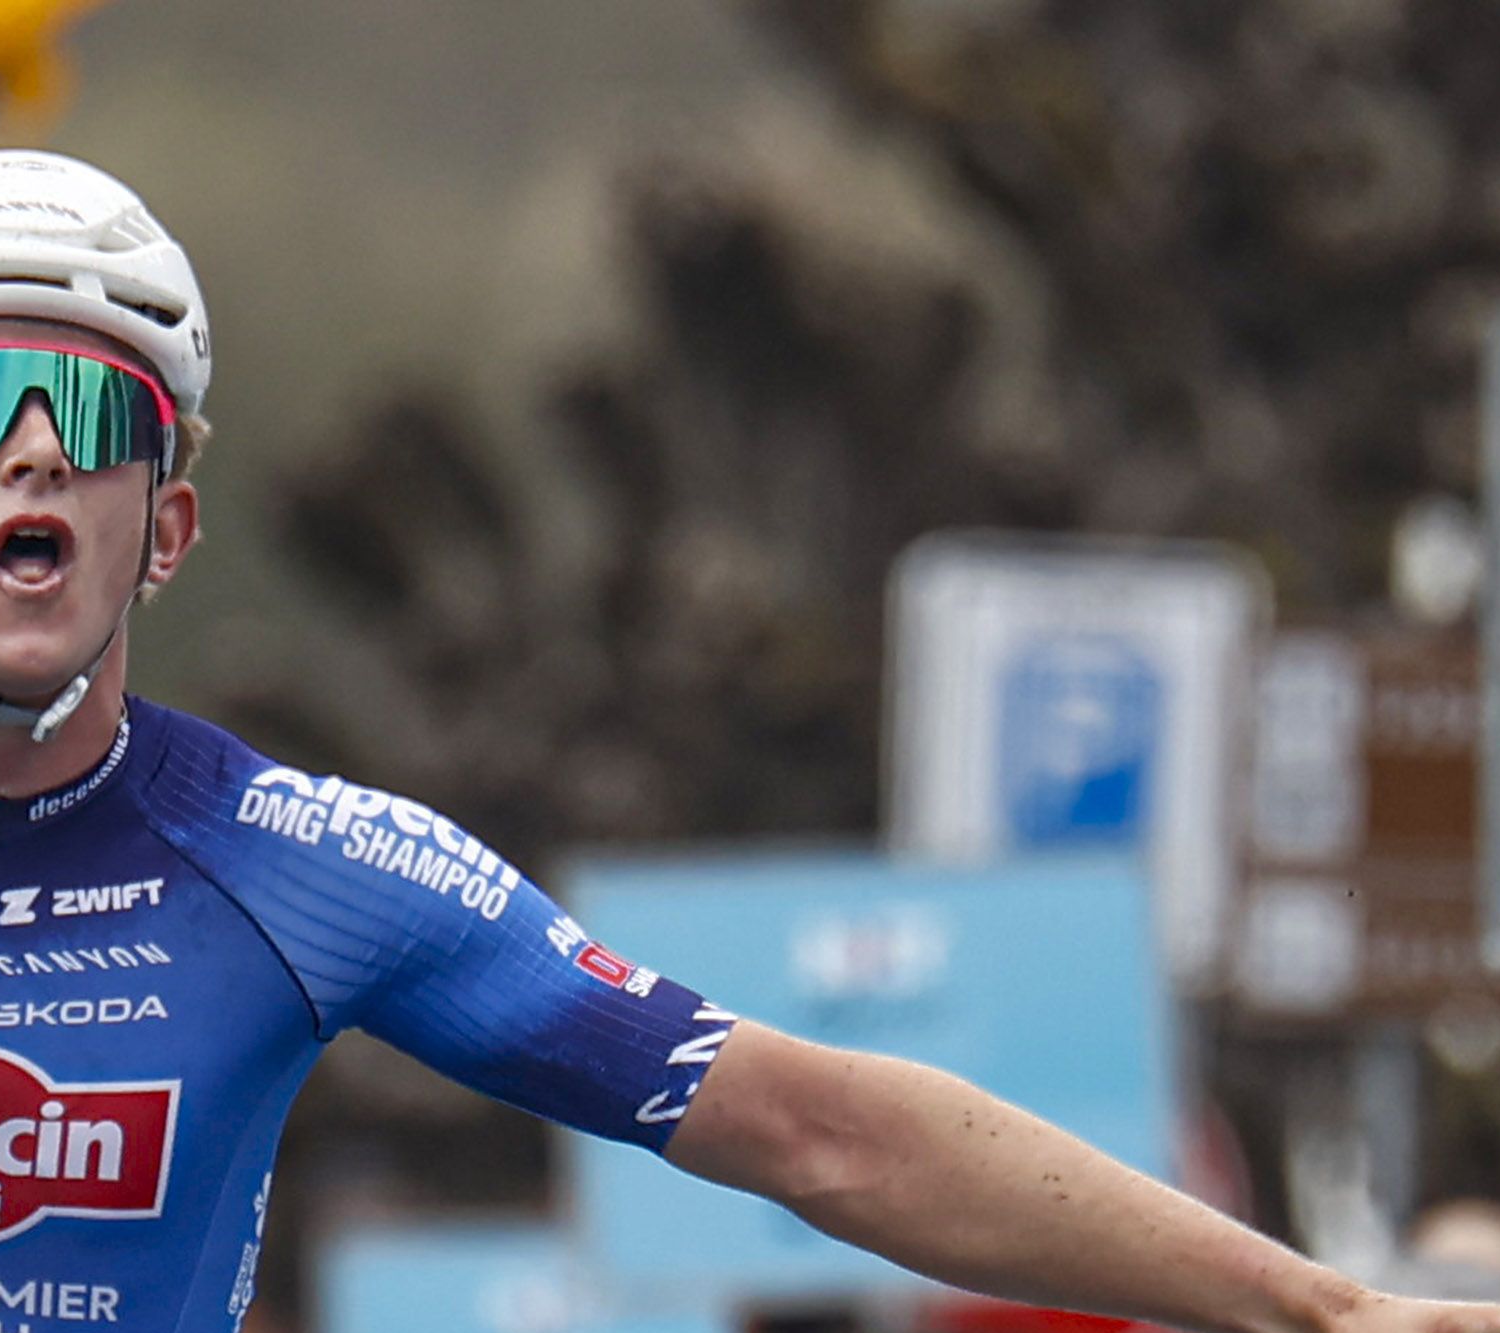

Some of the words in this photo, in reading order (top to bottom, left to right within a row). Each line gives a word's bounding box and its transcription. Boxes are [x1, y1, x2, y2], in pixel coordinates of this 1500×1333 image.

[52, 877, 164, 916] ZWIFT
[237, 787, 327, 845] DMG
[342, 820, 509, 921] SHAMPOO
